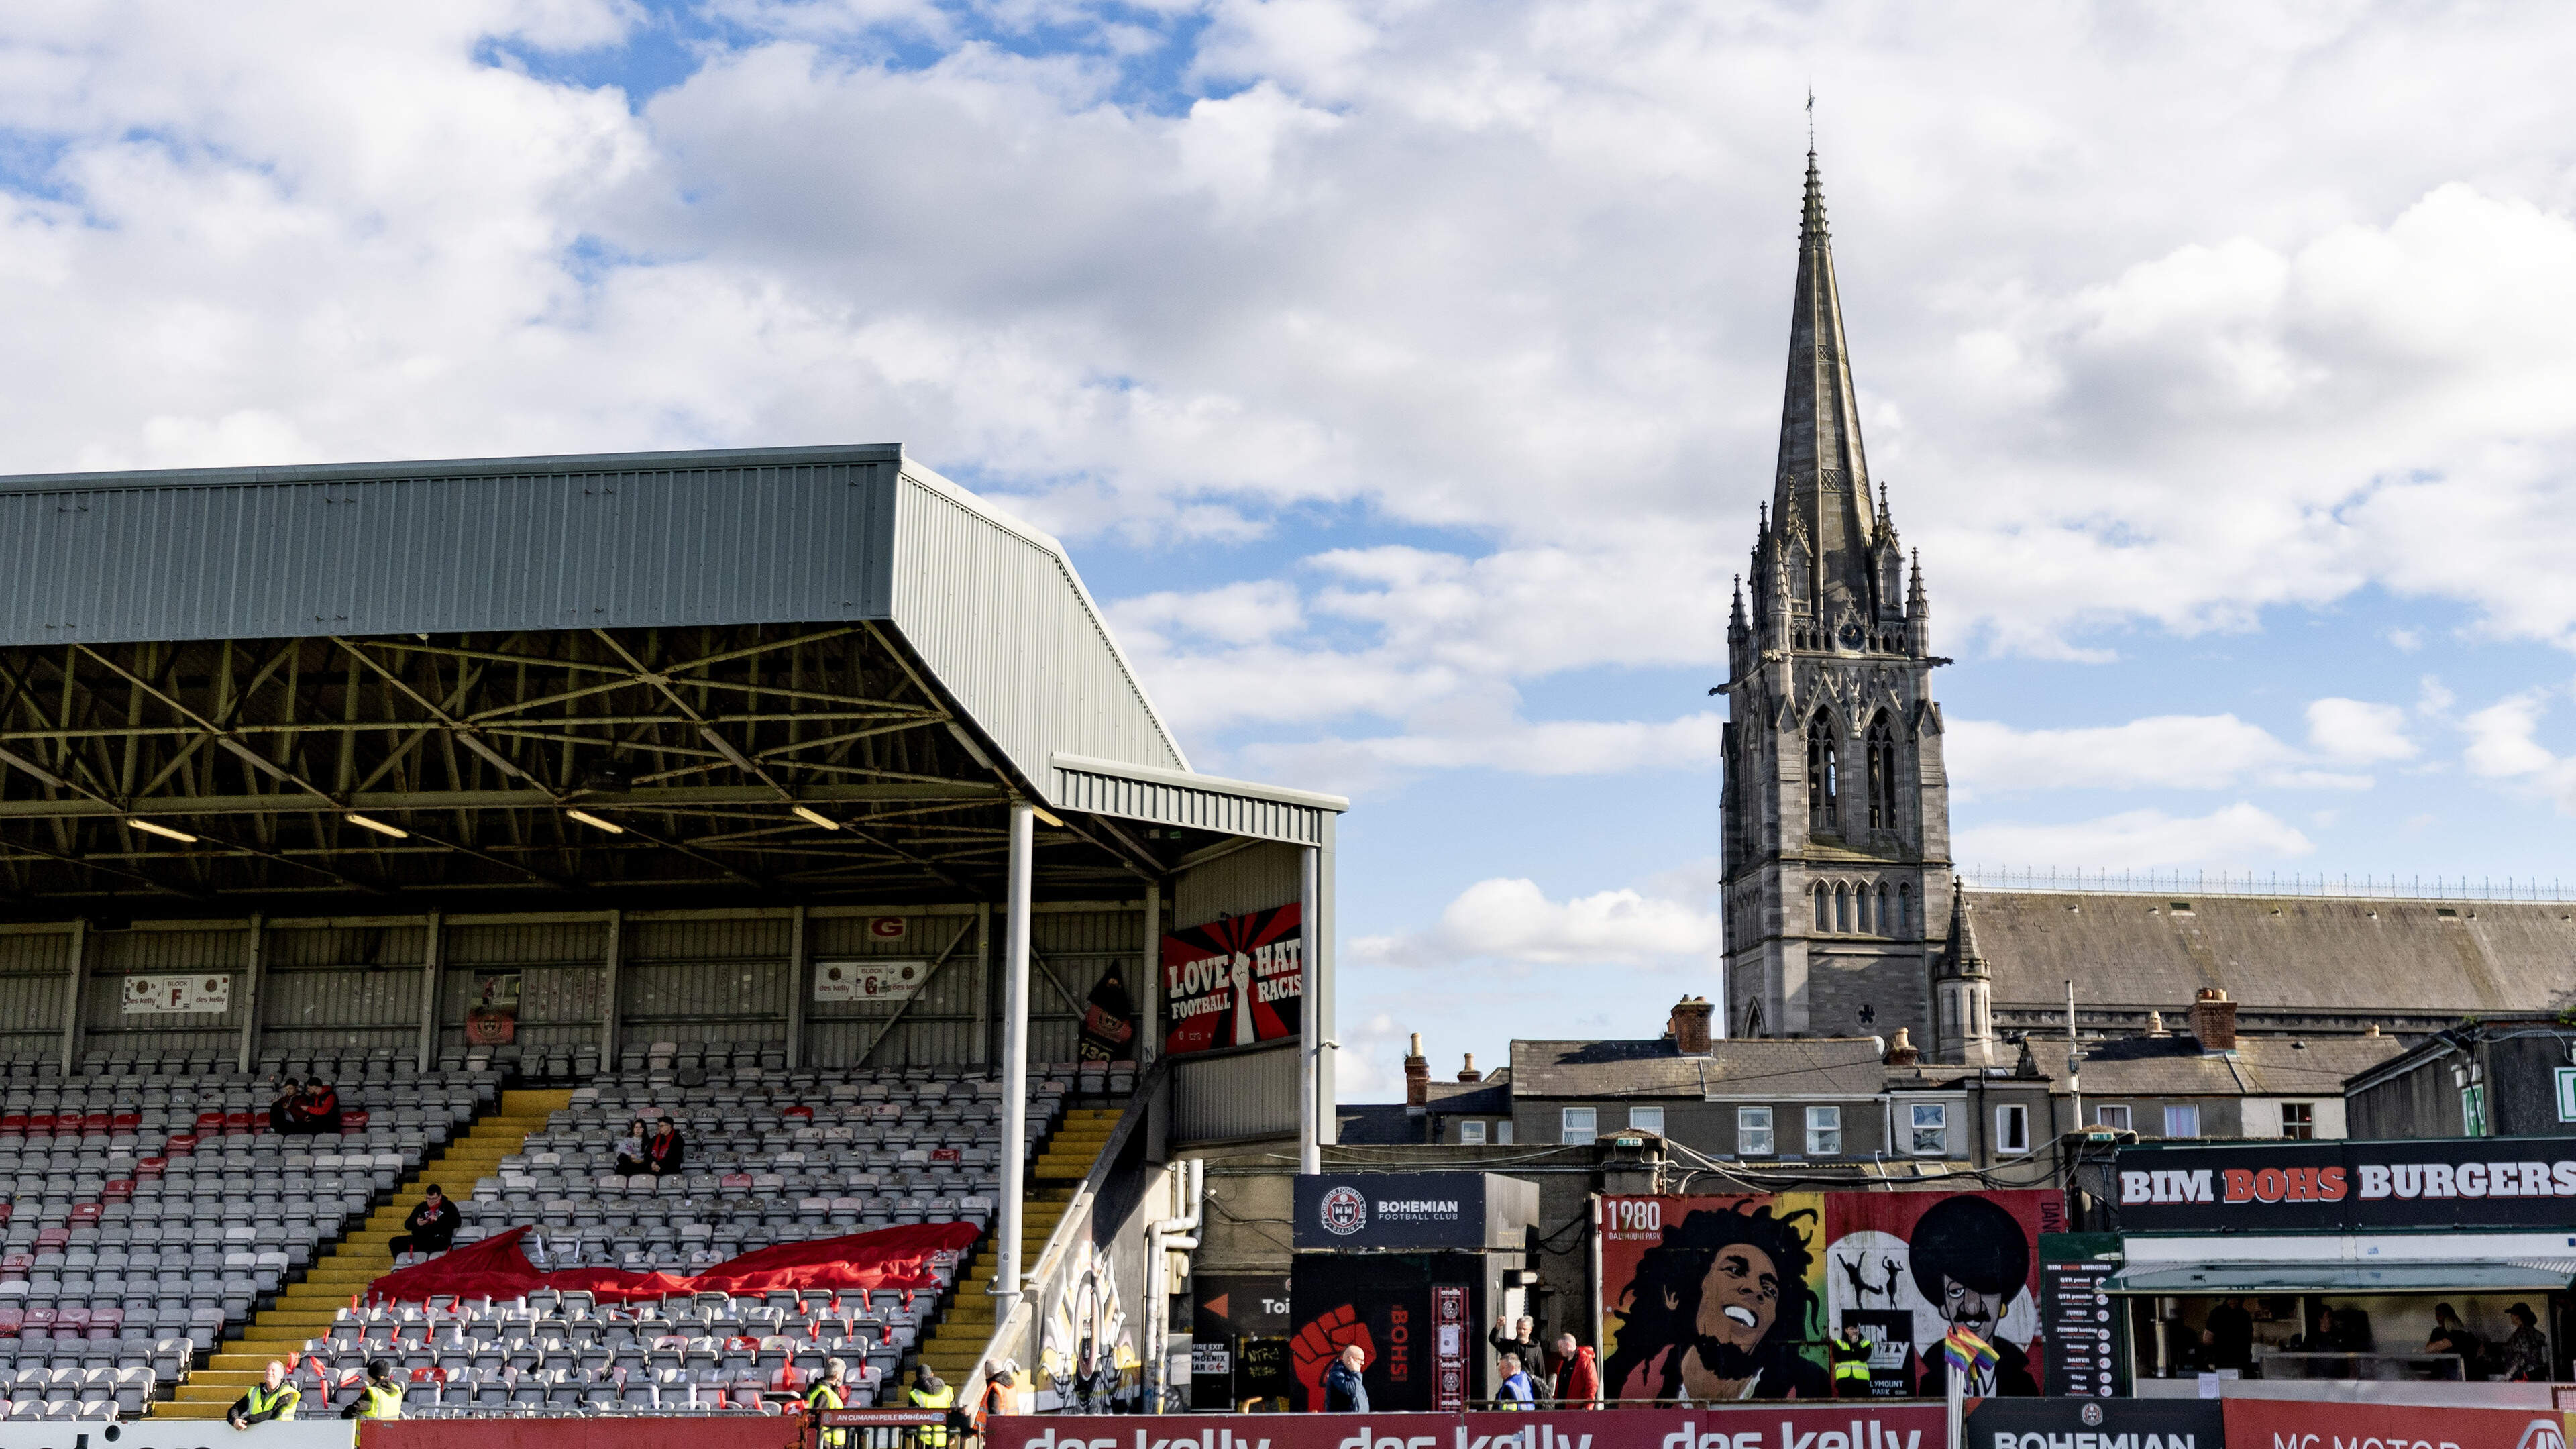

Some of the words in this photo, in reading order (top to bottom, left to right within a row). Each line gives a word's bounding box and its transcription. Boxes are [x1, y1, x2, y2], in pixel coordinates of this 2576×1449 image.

[871, 918, 903, 936] G
[1169, 955, 1230, 999] LOVE
[1255, 938, 1301, 977] HAT
[833, 984, 849, 993] kelly
[1171, 993, 1230, 1020] FOOTBALL
[1258, 974, 1302, 1002] RACIS
[140, 997, 156, 1005] kelly
[171, 989, 182, 1007] F
[209, 996, 225, 1004] kelly
[2120, 1169, 2214, 1205] BIM
[2224, 1166, 2348, 1203] BOHS
[2358, 1161, 2576, 1200] BURGERS
[1379, 1201, 1458, 1213] BOHEMIAN
[1608, 1201, 1660, 1231] 1980
[1609, 1232, 1644, 1240] DALYMOUNT
[1645, 1232, 1661, 1240] PARK
[1860, 1324, 1887, 1342] HIN
[1391, 1310, 1409, 1375] BOHS
[1869, 1380, 1904, 1388] LYMOUNT
[898, 1412, 932, 1421] BÓIHÉAM
[1994, 1432, 2195, 1449] BOHEMIAN
